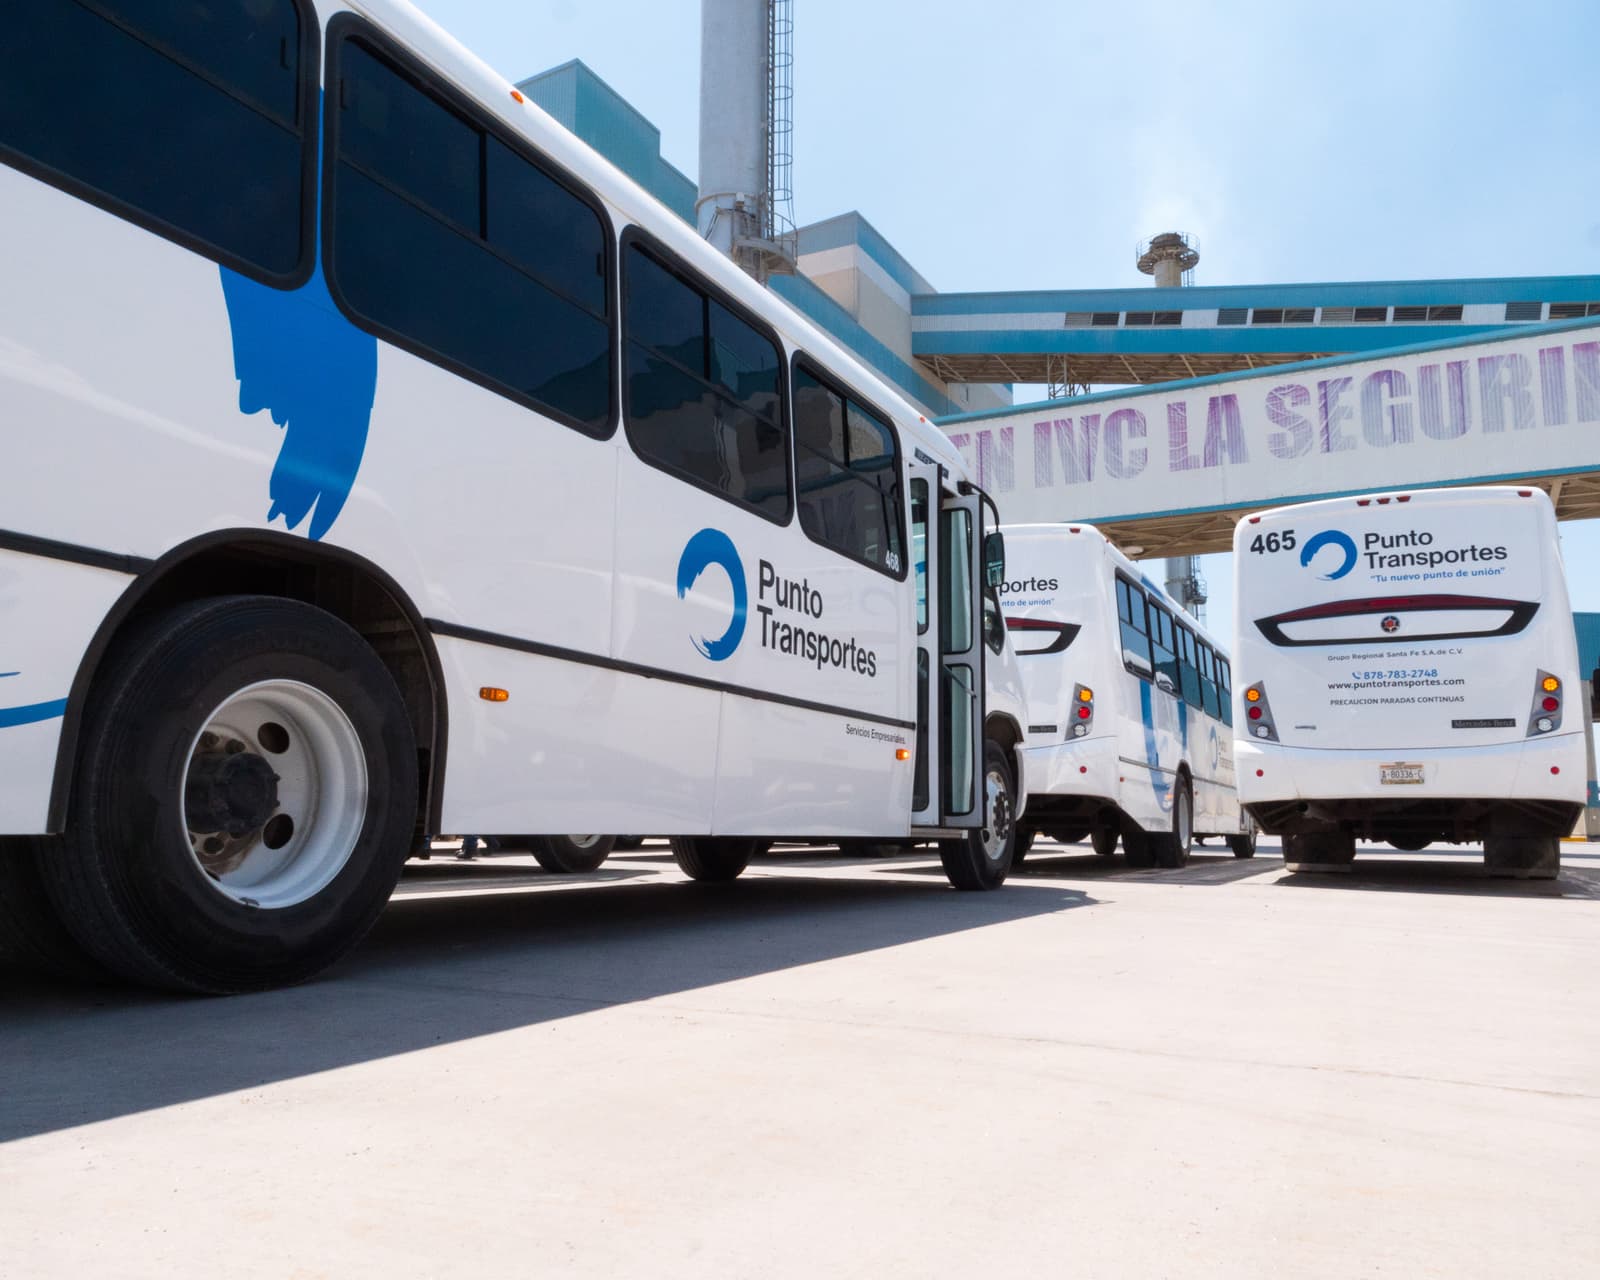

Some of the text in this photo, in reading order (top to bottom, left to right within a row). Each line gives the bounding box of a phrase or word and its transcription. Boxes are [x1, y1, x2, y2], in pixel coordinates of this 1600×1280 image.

[1166, 393, 1249, 472] LA
[1250, 529, 1296, 555] 465
[1364, 530, 1433, 550] Punto
[885, 550, 900, 572] 468
[1364, 544, 1508, 569] Transportes
[1390, 573, 1421, 582] nuevo
[1423, 571, 1453, 581] punto
[1455, 569, 1469, 577] de
[759, 558, 823, 619] Punto
[999, 577, 1059, 597] portes
[757, 604, 877, 678] Transportes
[1351, 652, 1385, 660] Regional
[1327, 678, 1465, 690] www.puntotransportes.com
[1363, 668, 1438, 680] 878-783-2748
[1329, 698, 1379, 706] PRECAUCION
[845, 723, 870, 739] Servicios
